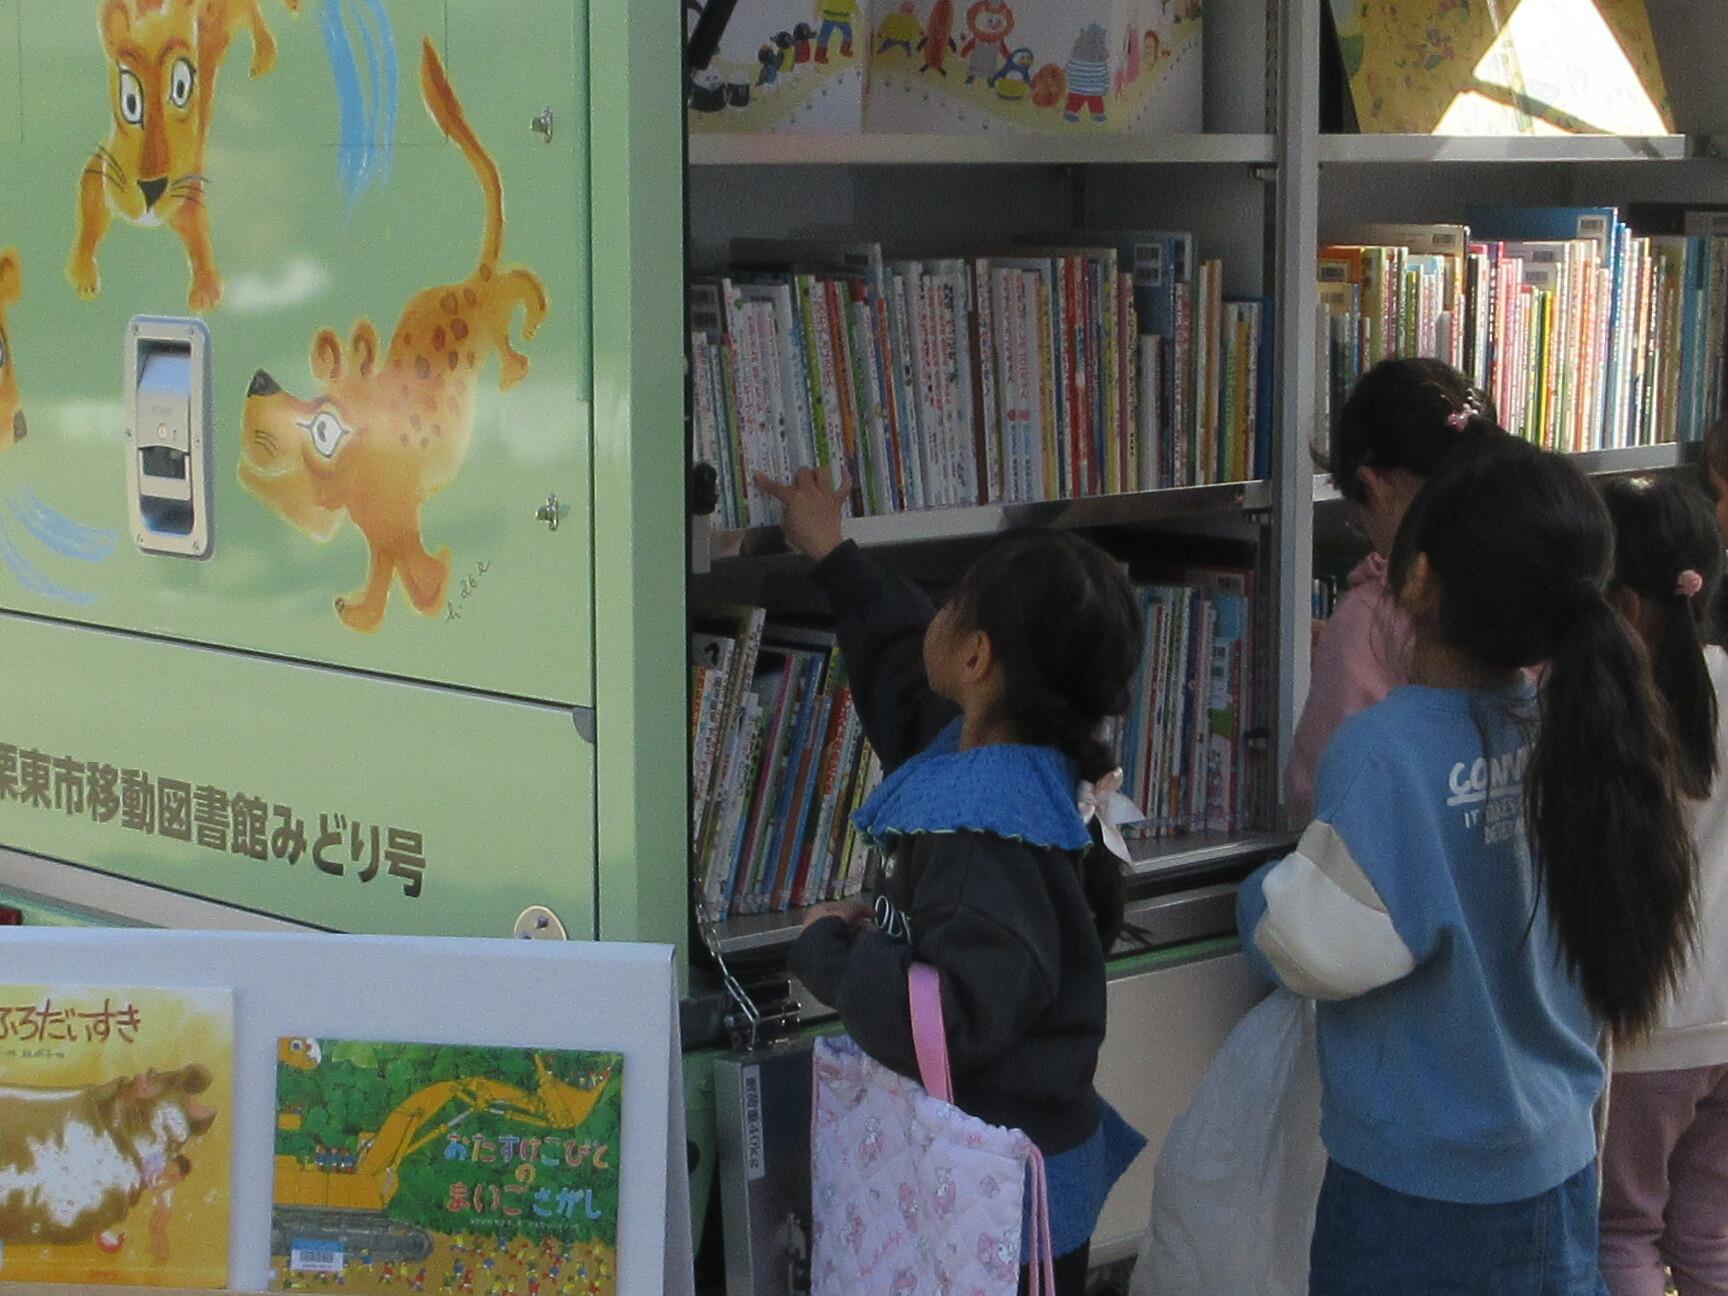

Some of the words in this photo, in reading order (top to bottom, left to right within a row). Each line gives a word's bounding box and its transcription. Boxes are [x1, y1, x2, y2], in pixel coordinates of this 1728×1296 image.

[443, 1132, 609, 1170] おたすけこびと
[515, 1163, 536, 1184] の
